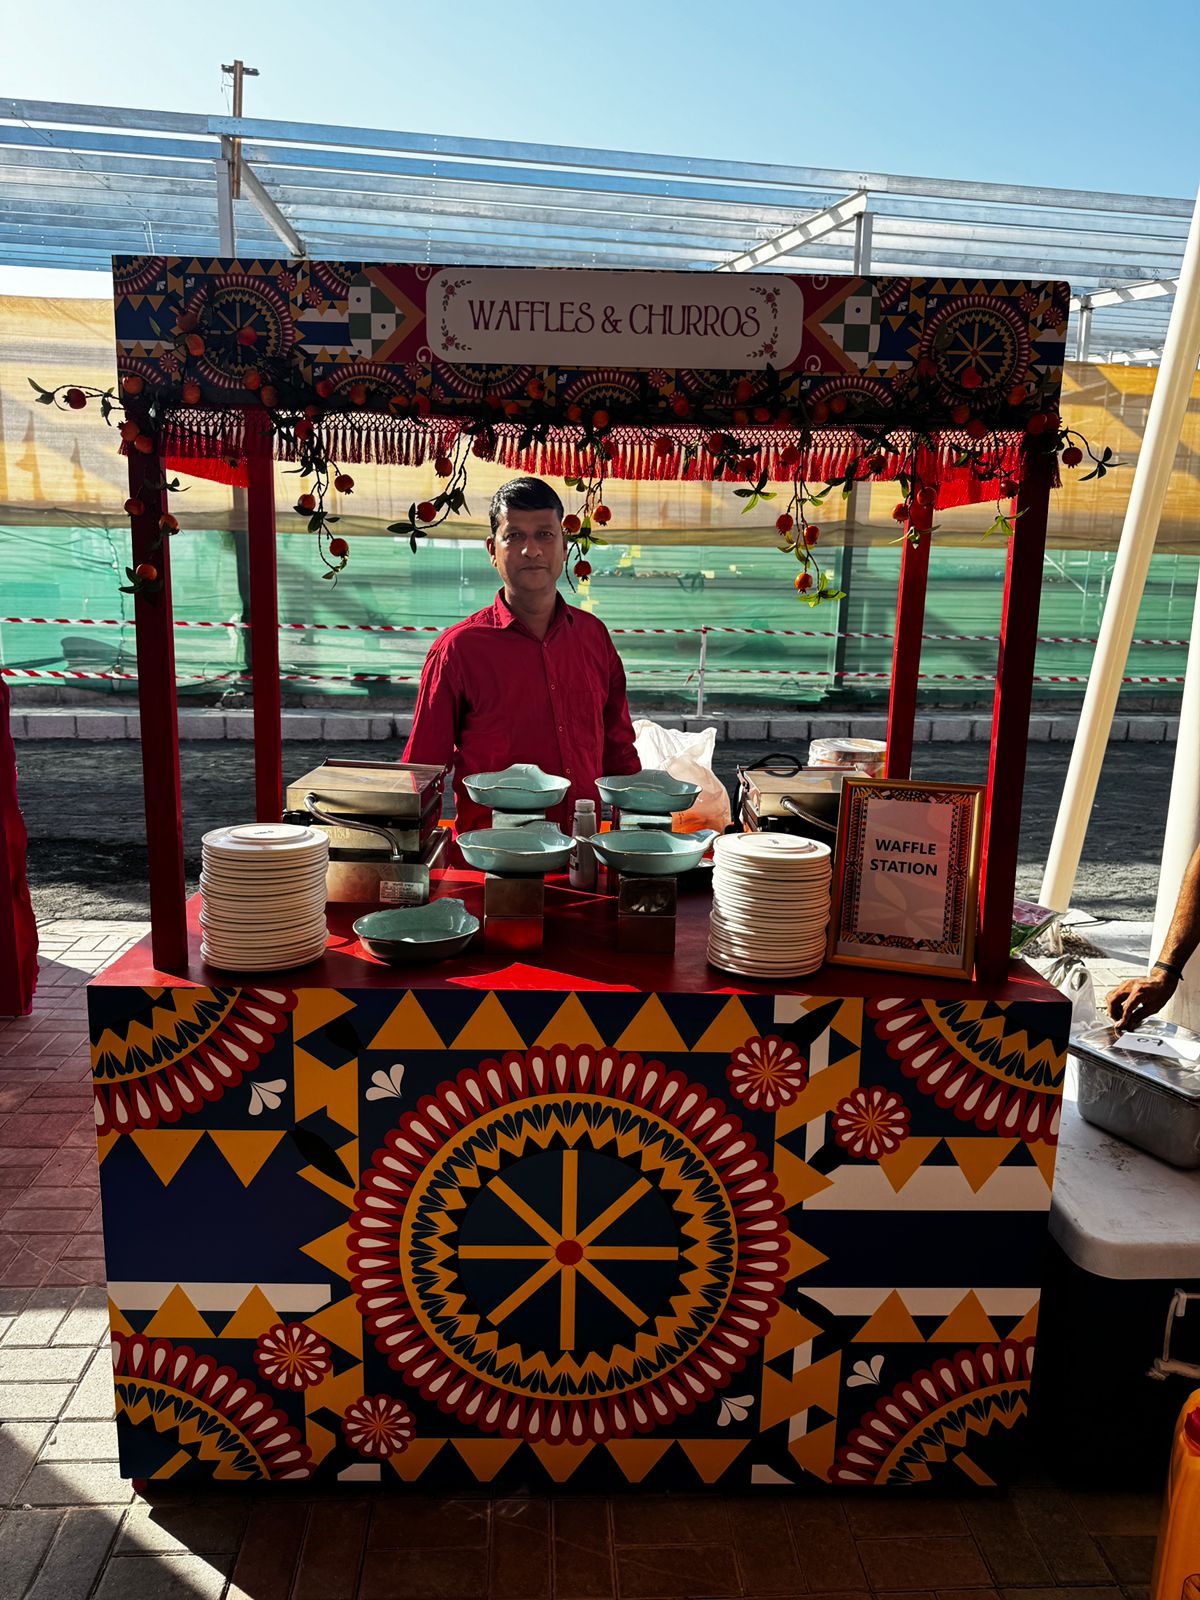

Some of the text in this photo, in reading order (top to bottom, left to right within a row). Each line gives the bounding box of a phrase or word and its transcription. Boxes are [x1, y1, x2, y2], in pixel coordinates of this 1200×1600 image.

[468, 300, 761, 337] WAFFLES & CHURROS
[875, 838, 936, 855] WAFFLE
[870, 858, 938, 876] STATION
